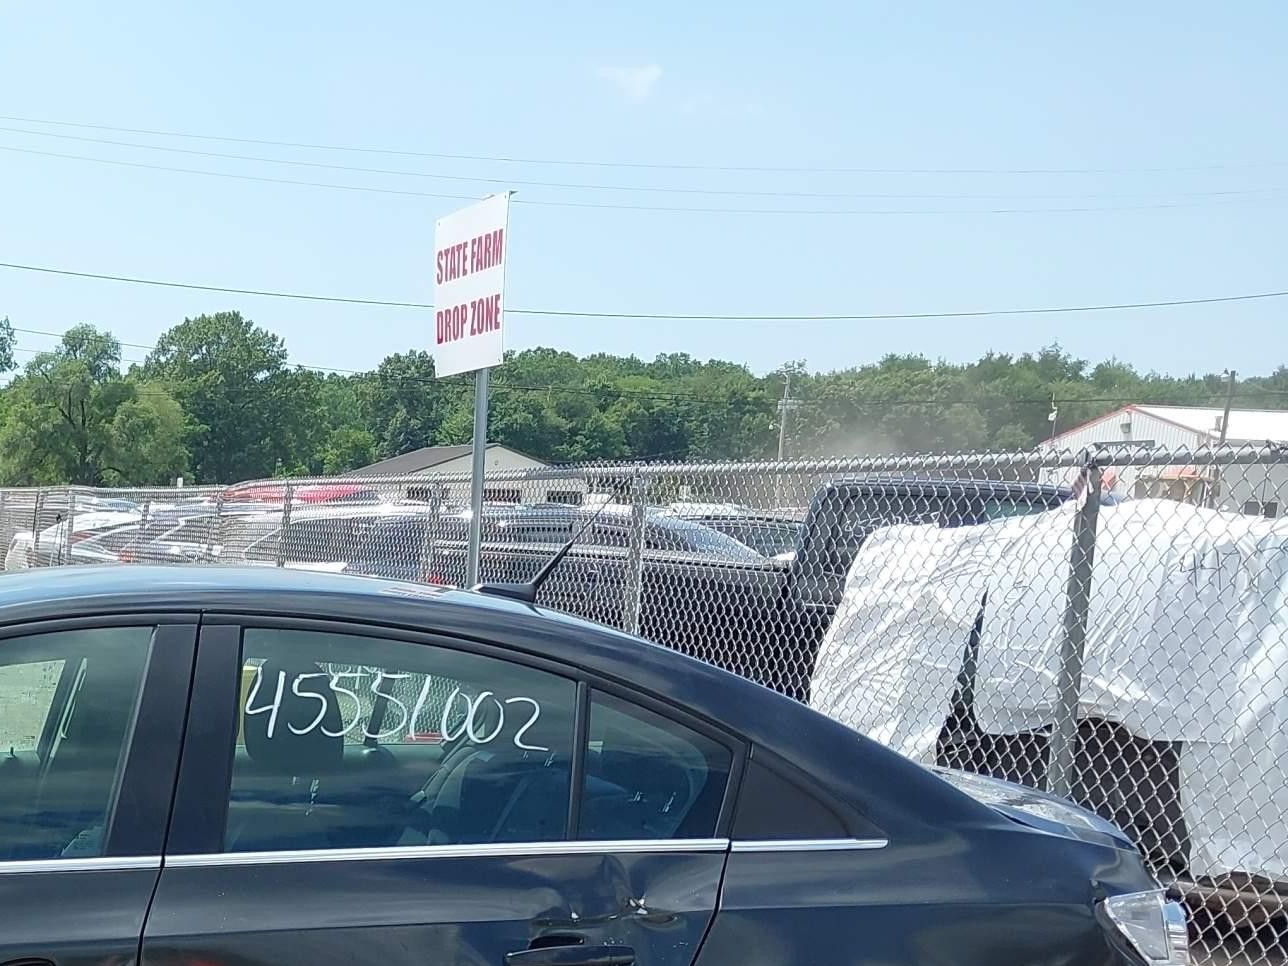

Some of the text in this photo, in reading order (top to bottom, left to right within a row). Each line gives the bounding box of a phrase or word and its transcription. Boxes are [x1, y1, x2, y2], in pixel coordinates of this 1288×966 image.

[436, 228, 504, 285] STATE FARM
[436, 293, 501, 345] DROP ZONE
[245, 664, 549, 752] 45551002
